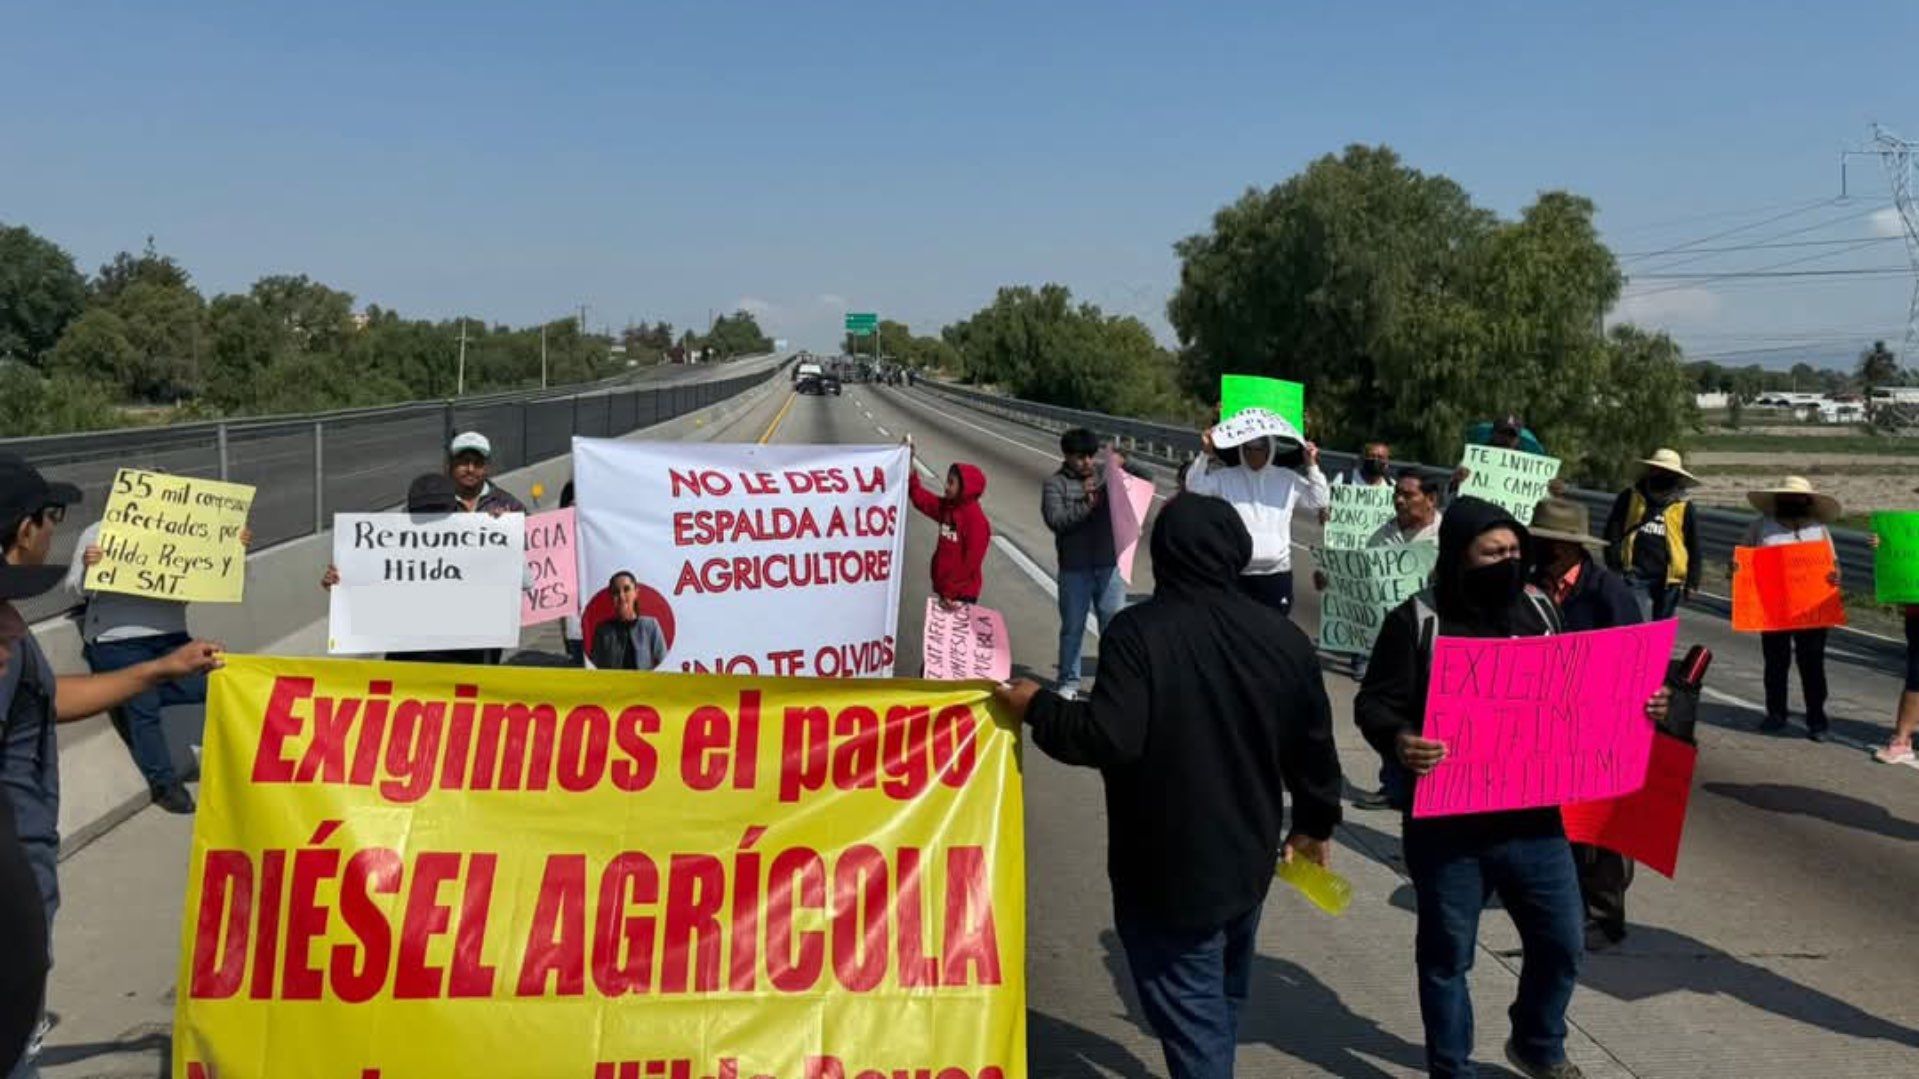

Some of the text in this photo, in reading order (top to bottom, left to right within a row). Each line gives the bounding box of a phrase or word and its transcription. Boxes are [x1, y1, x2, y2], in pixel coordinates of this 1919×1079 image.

[1469, 448, 1555, 477] TE INVITO
[115, 471, 153, 499] 55
[161, 483, 191, 505] mil
[668, 466, 887, 497] NO LE DES LA
[219, 525, 240, 544] por
[354, 521, 508, 550] Renuncia
[673, 505, 897, 546] ESPALDA A LOS
[101, 533, 233, 577] Hilda Reyes y
[384, 557, 464, 582] Hilda
[97, 567, 117, 585] el
[521, 583, 568, 611] YES
[767, 650, 805, 677] TE
[252, 677, 977, 804] Exigimos el pago
[190, 821, 1002, 1004] DIÉSEL AGRÍCOLA
